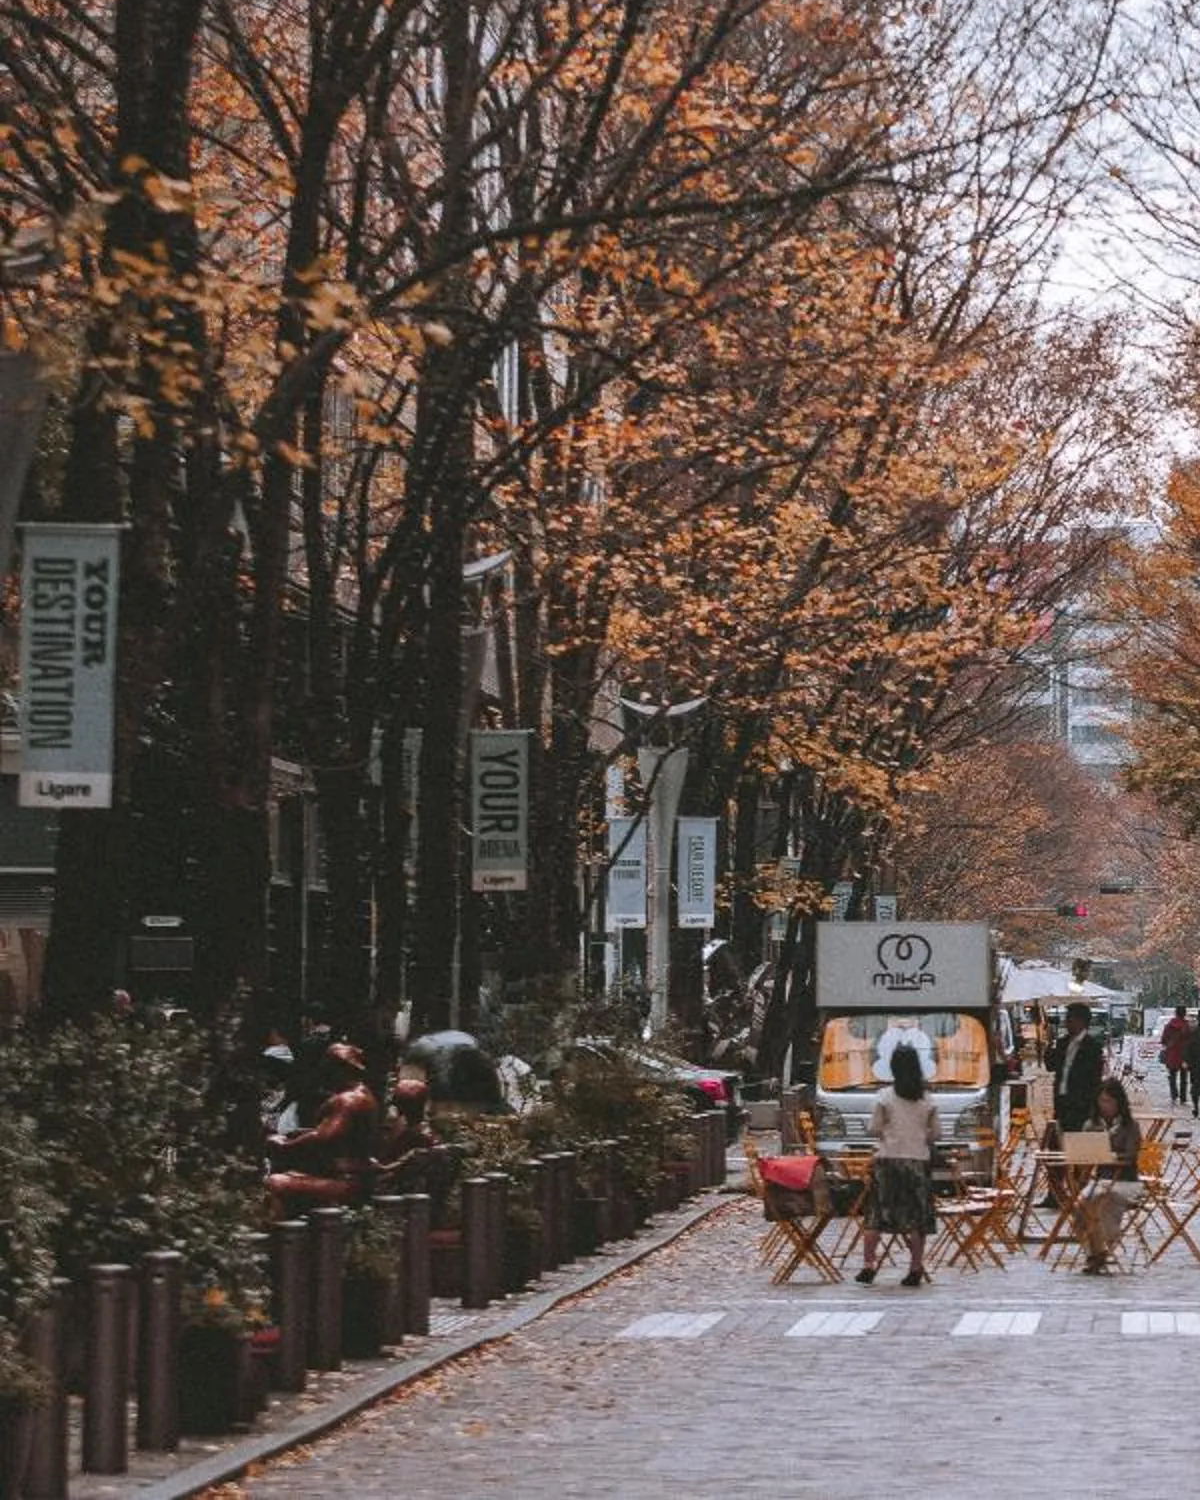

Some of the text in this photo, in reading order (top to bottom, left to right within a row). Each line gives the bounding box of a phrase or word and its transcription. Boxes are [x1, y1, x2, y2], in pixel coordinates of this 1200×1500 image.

[28, 557, 77, 749] DESTINATION
[83, 559, 110, 669] YOUR
[38, 780, 92, 800] Ligare
[479, 750, 520, 834] YOUR
